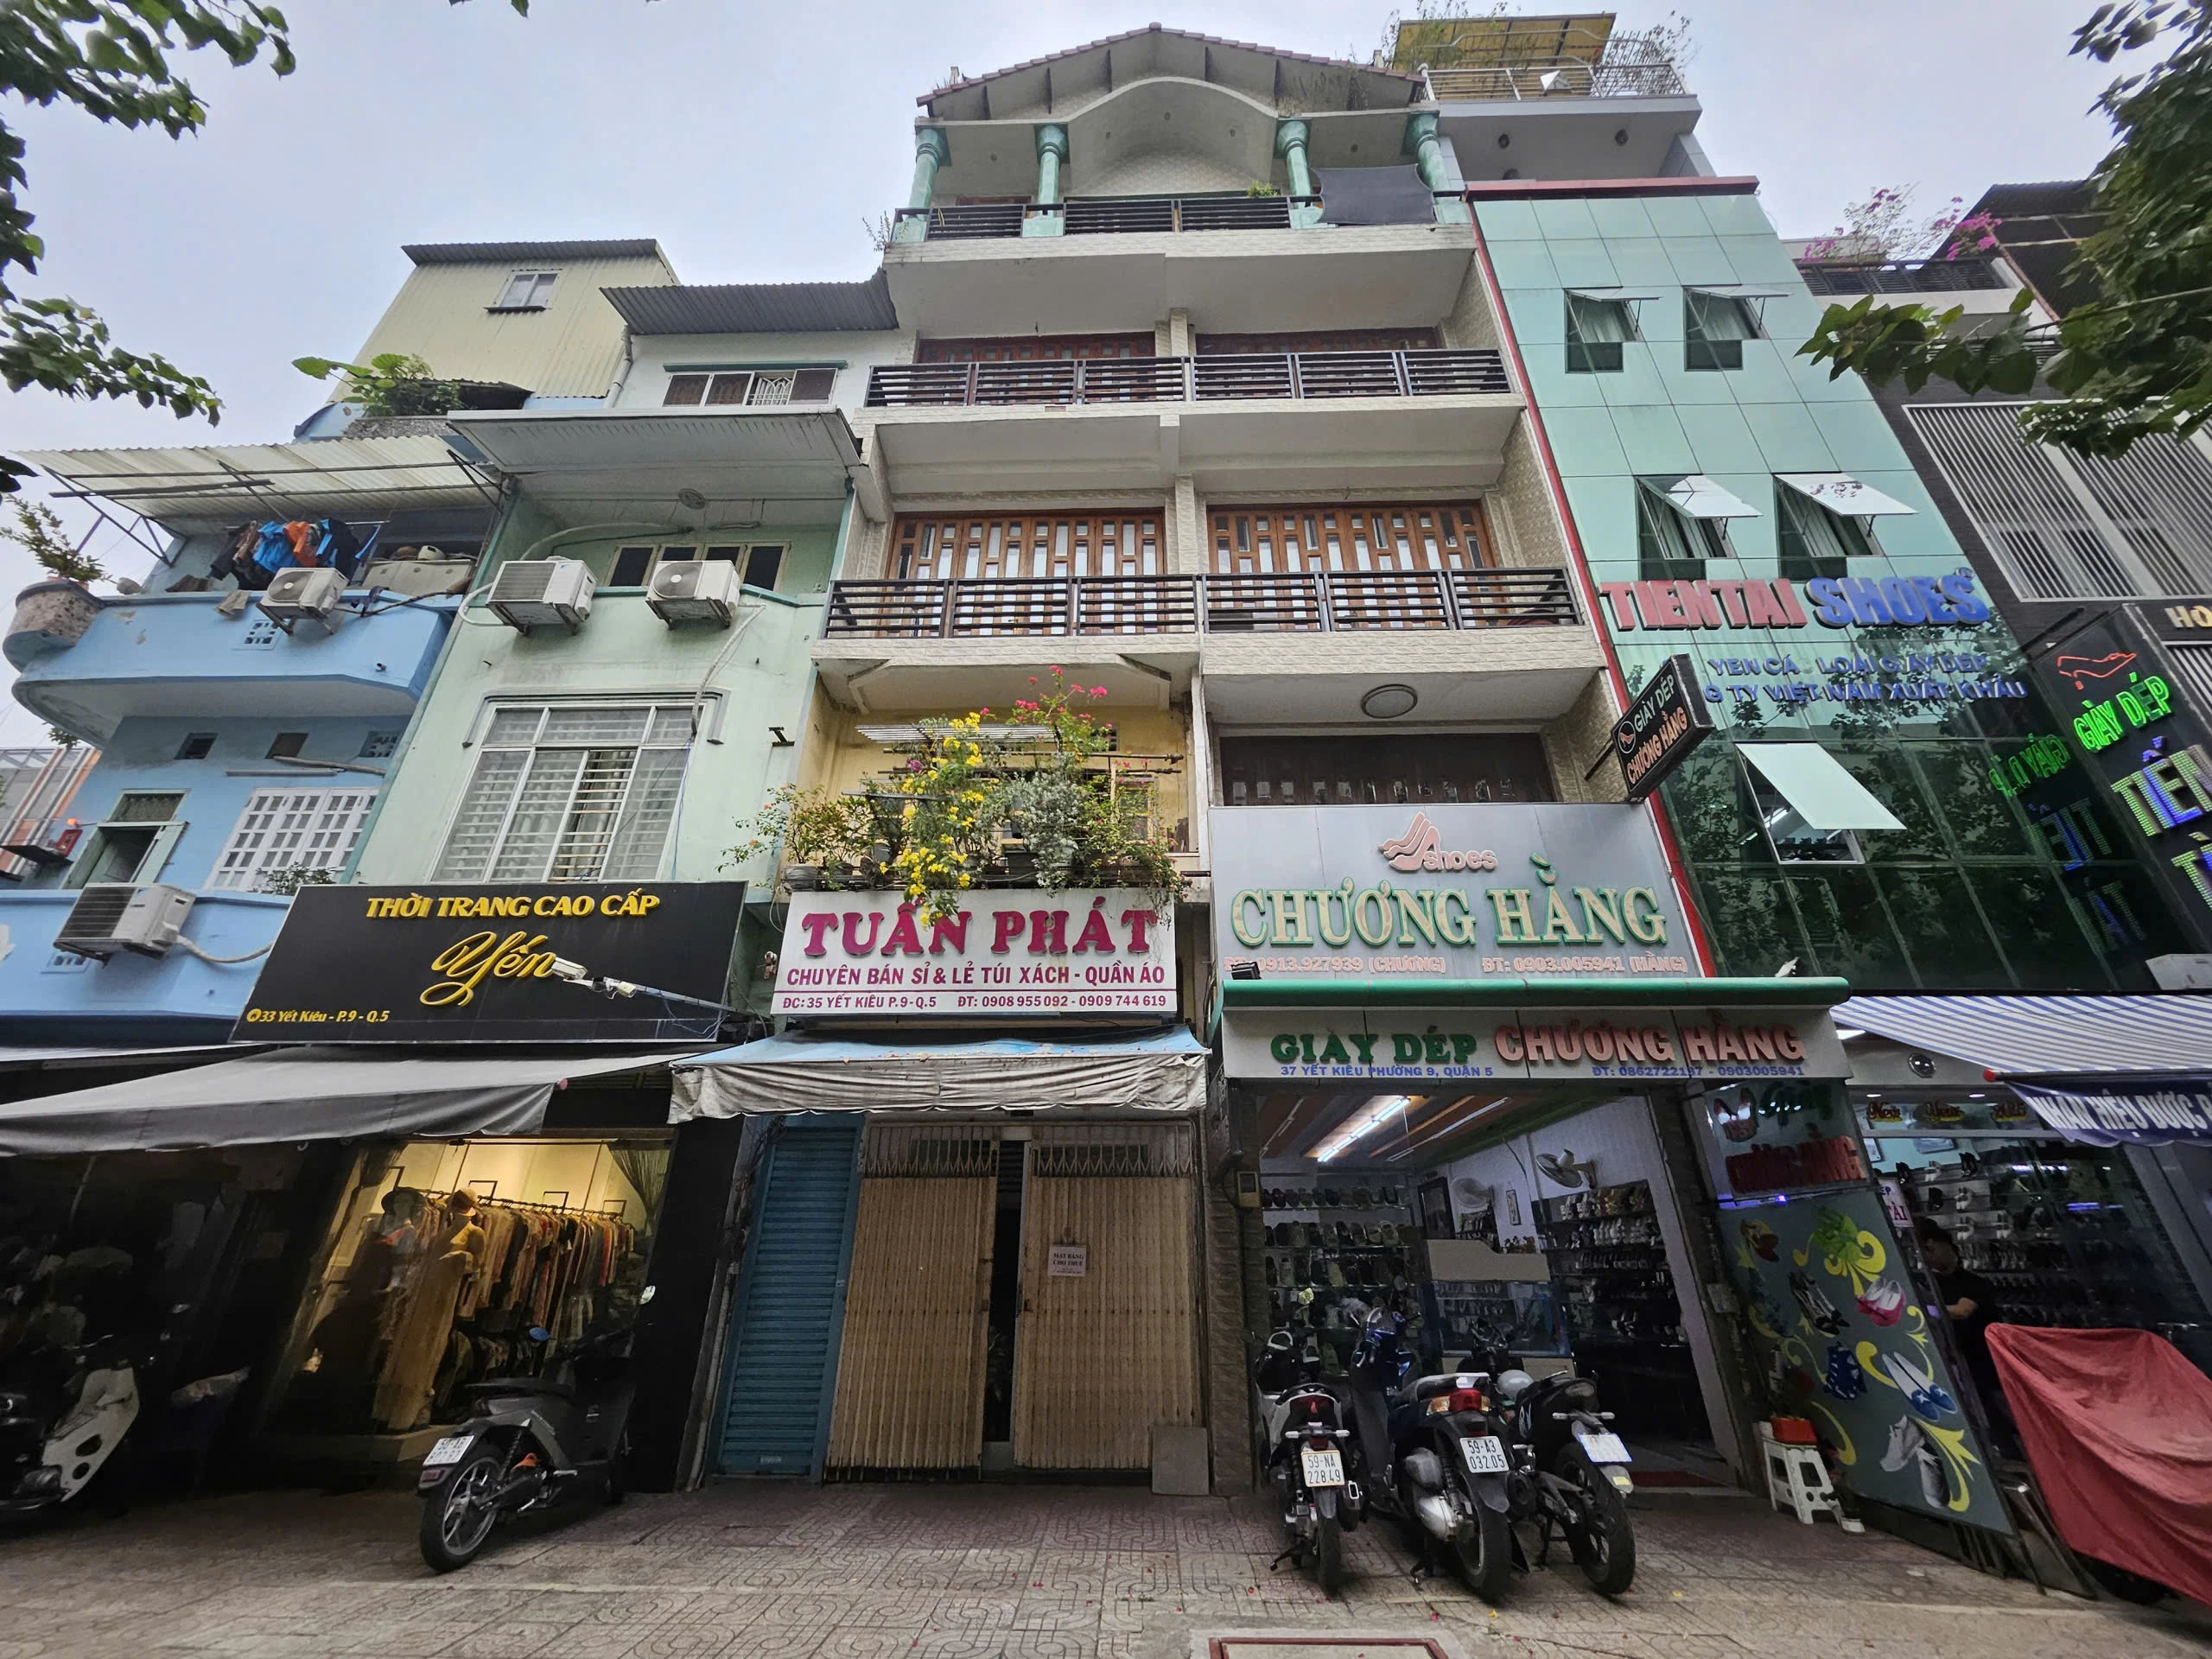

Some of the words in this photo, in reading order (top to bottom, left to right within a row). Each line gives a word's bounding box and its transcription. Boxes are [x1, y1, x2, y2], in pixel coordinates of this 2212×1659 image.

[1804, 575, 1989, 629] SHOES
[1634, 695, 1658, 733] GIÀY
[1655, 674, 1675, 709] DÉP
[1726, 684, 1759, 702] TY
[1822, 683, 1882, 702] NAM
[2074, 700, 2124, 752] GIÀY
[2116, 672, 2171, 728] DÉP
[1626, 734, 1662, 785] CHƯƠNG
[366, 893, 434, 918] THỜI
[436, 897, 531, 918] TRANG
[534, 895, 594, 918] CAO
[601, 887, 660, 917] CẤP
[1230, 876, 1476, 945] CHƯƠNG
[1486, 852, 1669, 945] HẰNG
[802, 897, 973, 956] TUẤN
[991, 895, 1158, 953] PHÁT
[419, 931, 557, 1007] Yến
[787, 964, 861, 986] CHUYÊN
[867, 963, 904, 985] BÁN
[911, 961, 931, 985] SỈ
[932, 967, 946, 984] &
[951, 961, 975, 984] LẺ
[981, 963, 1011, 983] TÚI
[1018, 963, 1070, 983] XÁCH
[1085, 960, 1135, 986] QUẦN
[1139, 962, 1165, 983] ÁO
[259, 1010, 276, 1022] 33
[336, 1010, 357, 1022] P.9
[366, 1010, 391, 1023] Q.5
[827, 993, 851, 1008] YẾT
[855, 995, 884, 1008] KIÊU
[958, 996, 977, 1007] ĐT:
[982, 996, 1014, 1007] 0908
[1079, 995, 1112, 1007] 0909
[1116, 995, 1139, 1006] 744
[1142, 995, 1166, 1006] 619
[1391, 1025, 1477, 1064] DÉP
[1495, 1019, 1674, 1063] CHƯƠNG
[1281, 1066, 1296, 1076] 37
[1301, 1063, 1327, 1076] YẾT
[1332, 1065, 1363, 1076] KIÊU
[1444, 1065, 1480, 1078] QUẬN
[1484, 1066, 1493, 1076] 5
